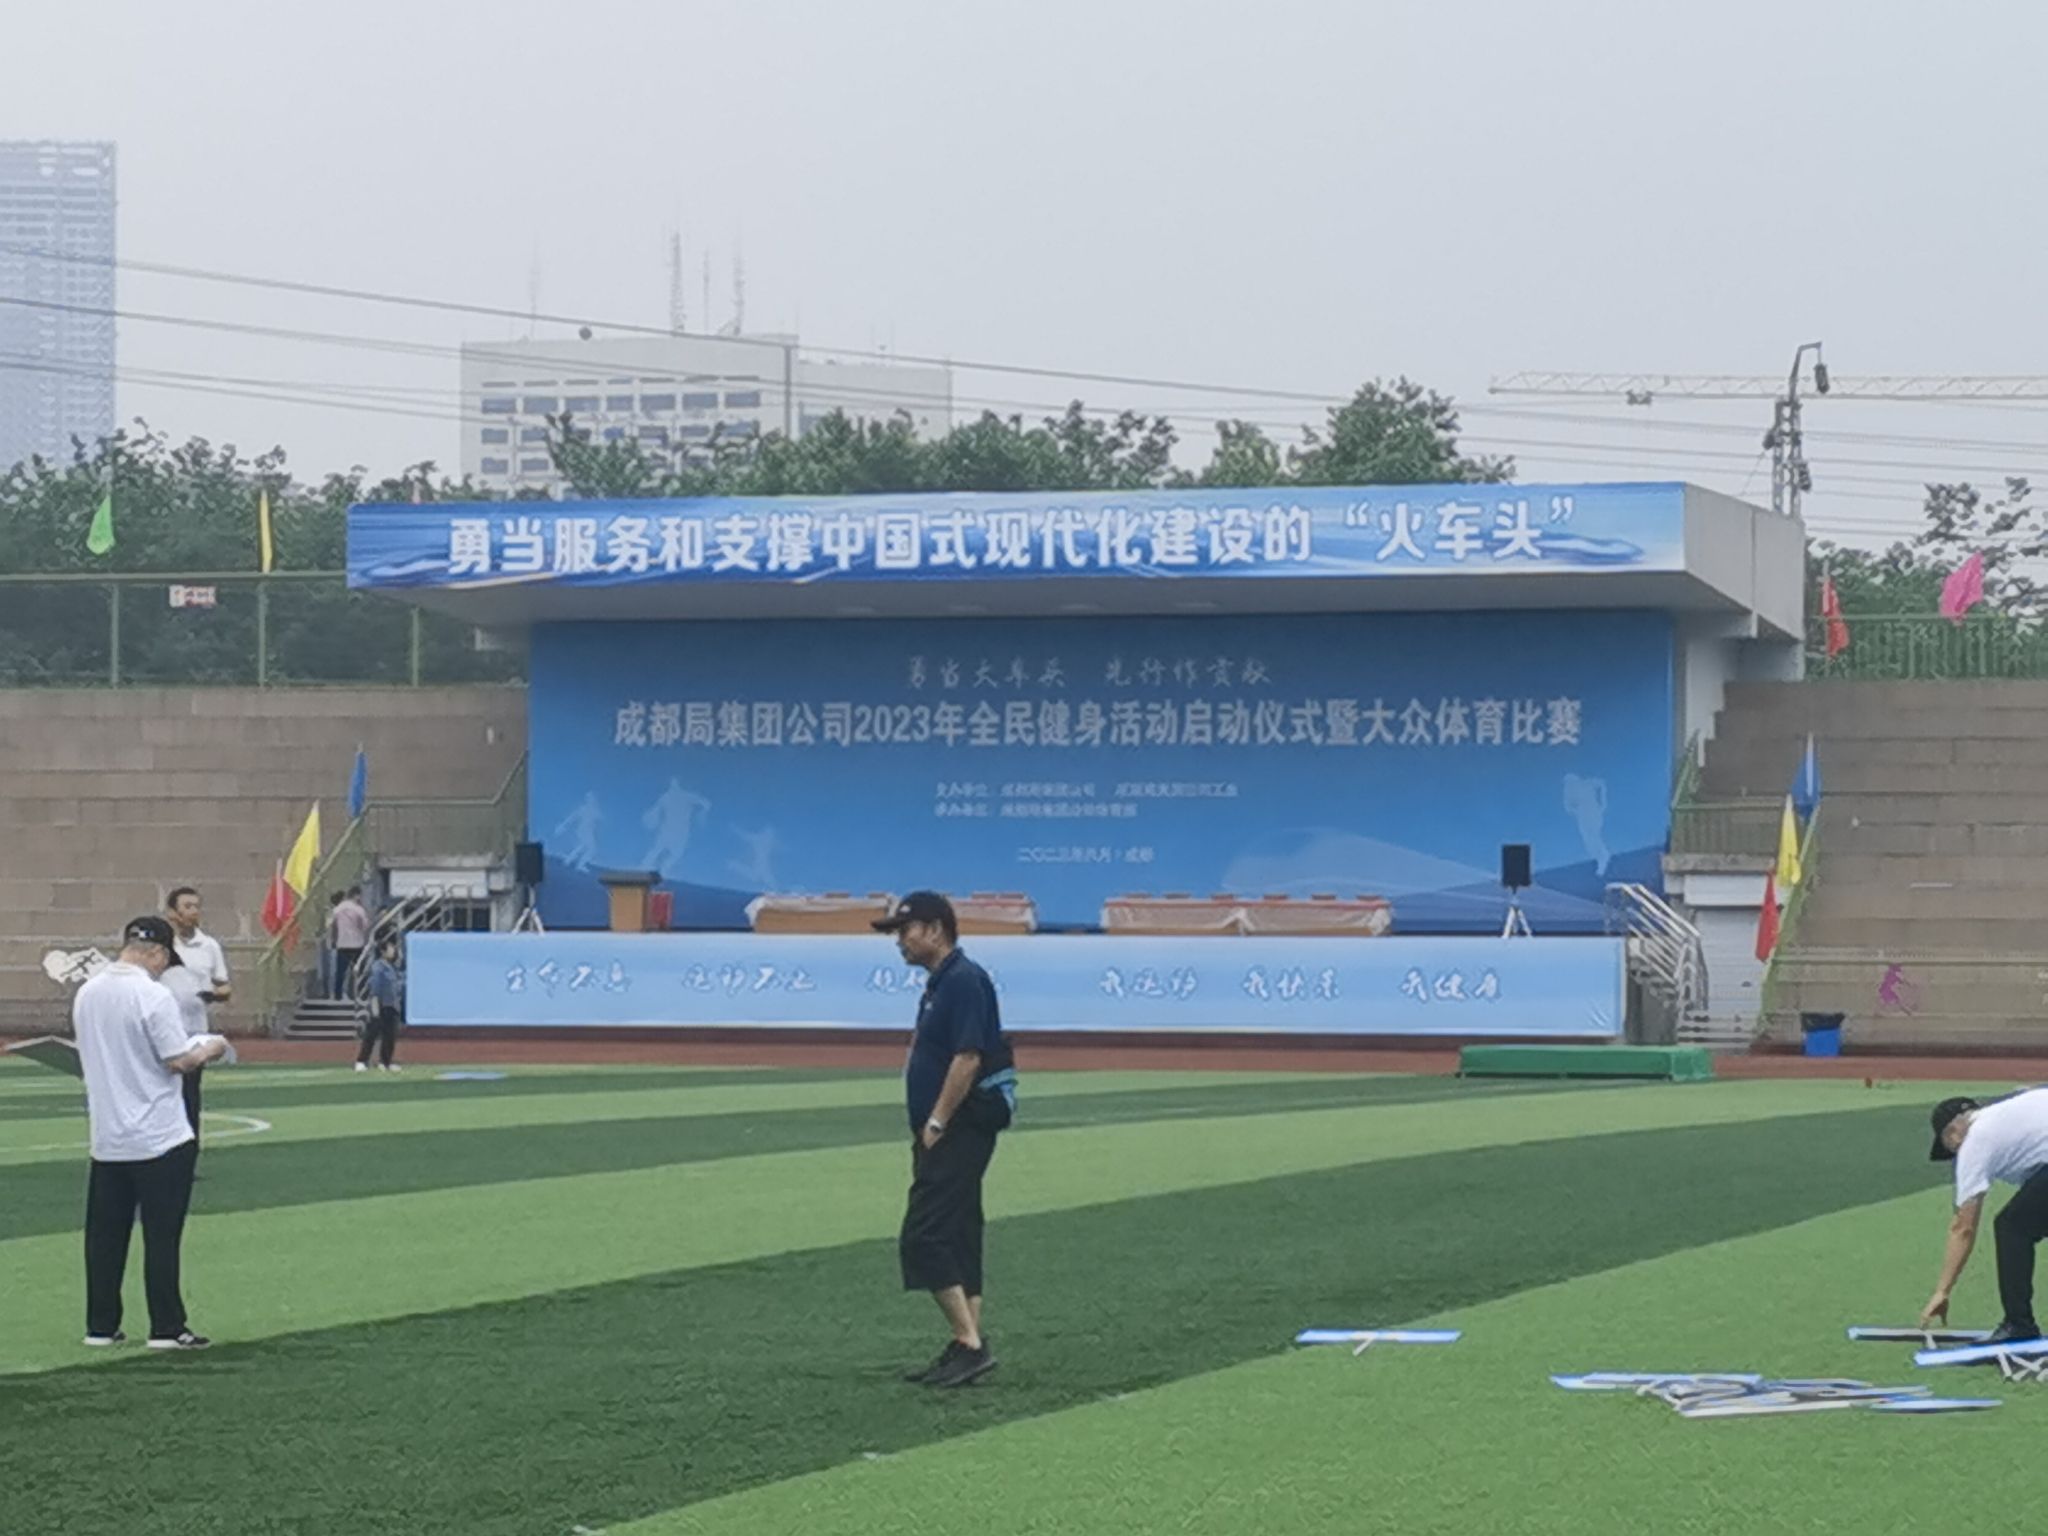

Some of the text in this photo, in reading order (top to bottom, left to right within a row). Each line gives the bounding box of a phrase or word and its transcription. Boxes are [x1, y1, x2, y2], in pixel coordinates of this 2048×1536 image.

[614, 696, 1582, 749] 成都局集团公司2023年全民健身活动启动仪式暨大众体育比赛
